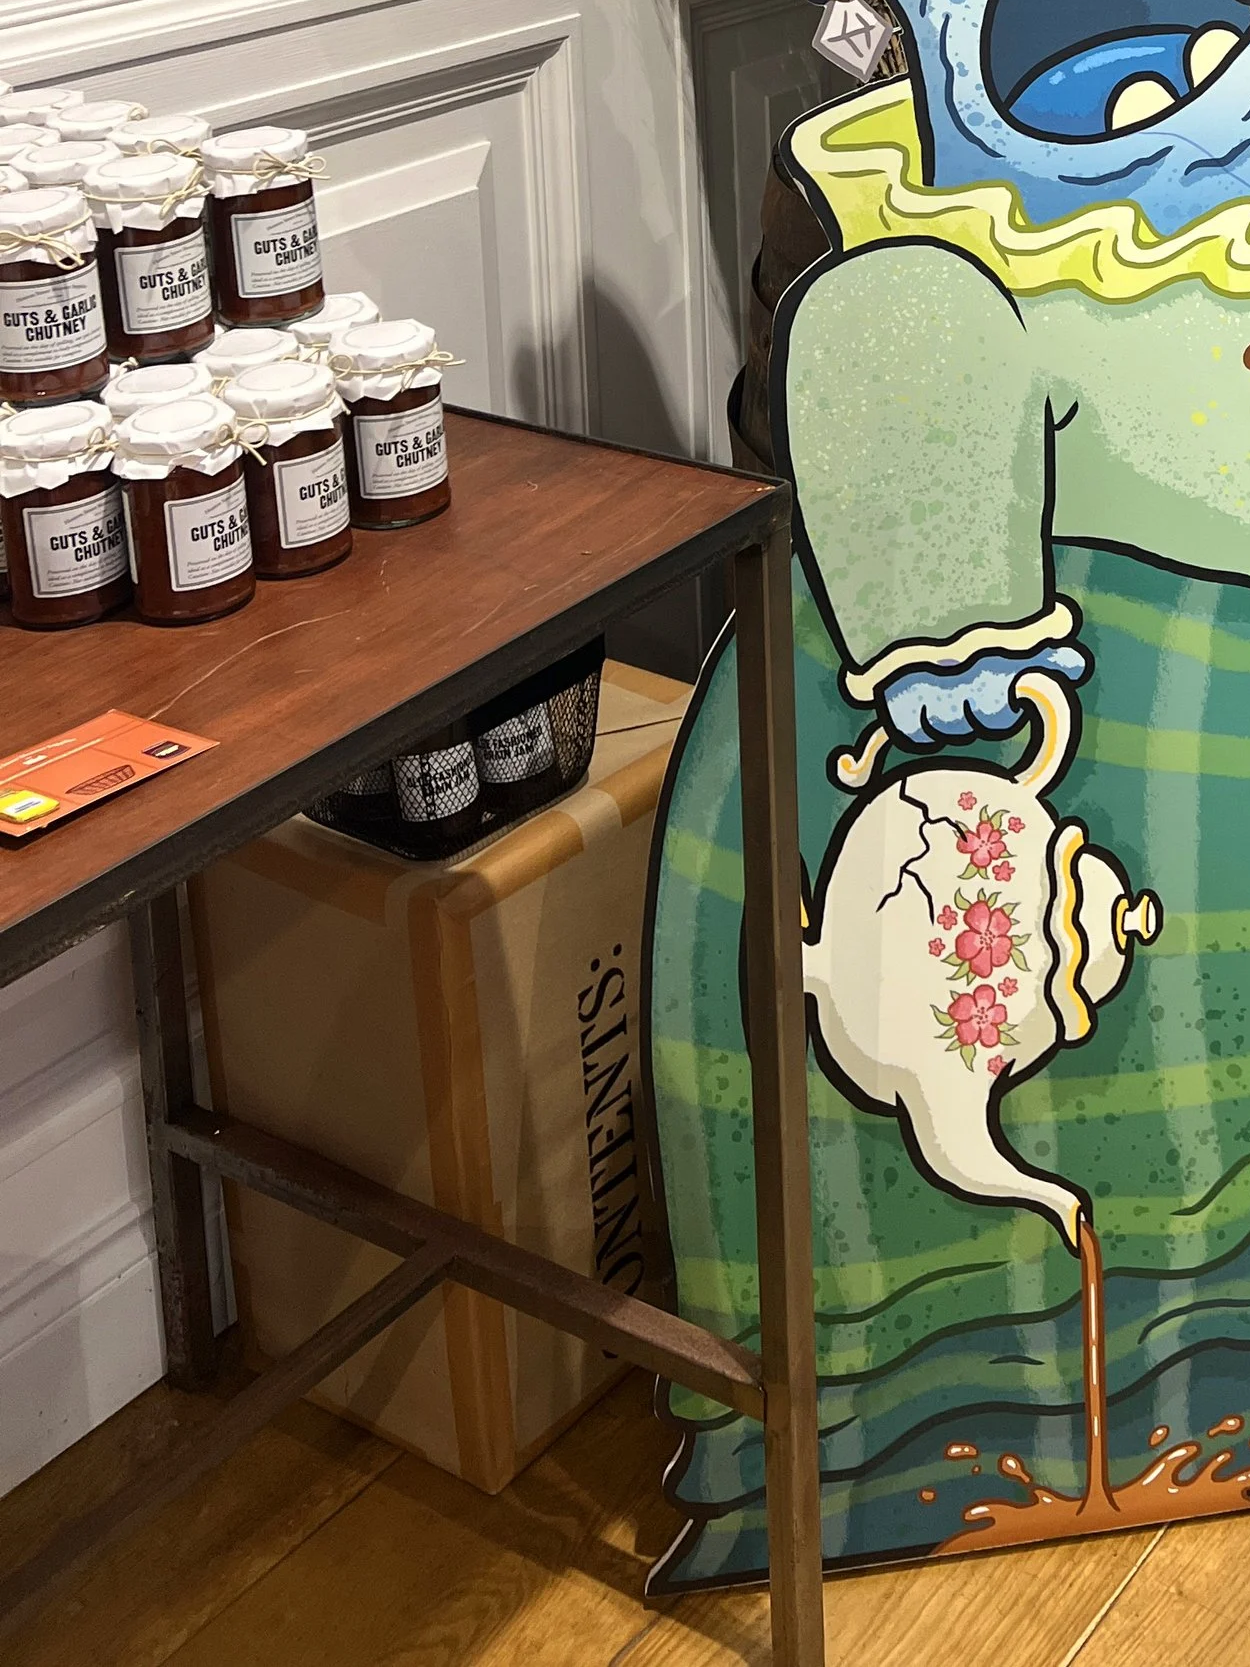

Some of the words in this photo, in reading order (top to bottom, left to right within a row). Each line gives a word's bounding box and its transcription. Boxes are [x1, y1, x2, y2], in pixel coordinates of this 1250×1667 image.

[254, 237, 288, 255] GUTS
[290, 234, 301, 248] &
[139, 271, 174, 289] GUTS
[178, 268, 189, 282] &
[4, 311, 39, 327] GUTS
[44, 309, 58, 324] &
[62, 294, 97, 320] GARLIC
[25, 315, 86, 342] CHUTNEY
[375, 439, 409, 456] GUTS
[412, 436, 423, 450] &
[396, 438, 442, 468] CHUTNEY
[299, 478, 330, 500] GUTS
[332, 473, 340, 487] &
[50, 531, 88, 551] GUTS
[92, 525, 105, 541] &
[190, 519, 225, 542] GUTS
[228, 514, 238, 530] &
[578, 941, 646, 1359] ONTENTS:
